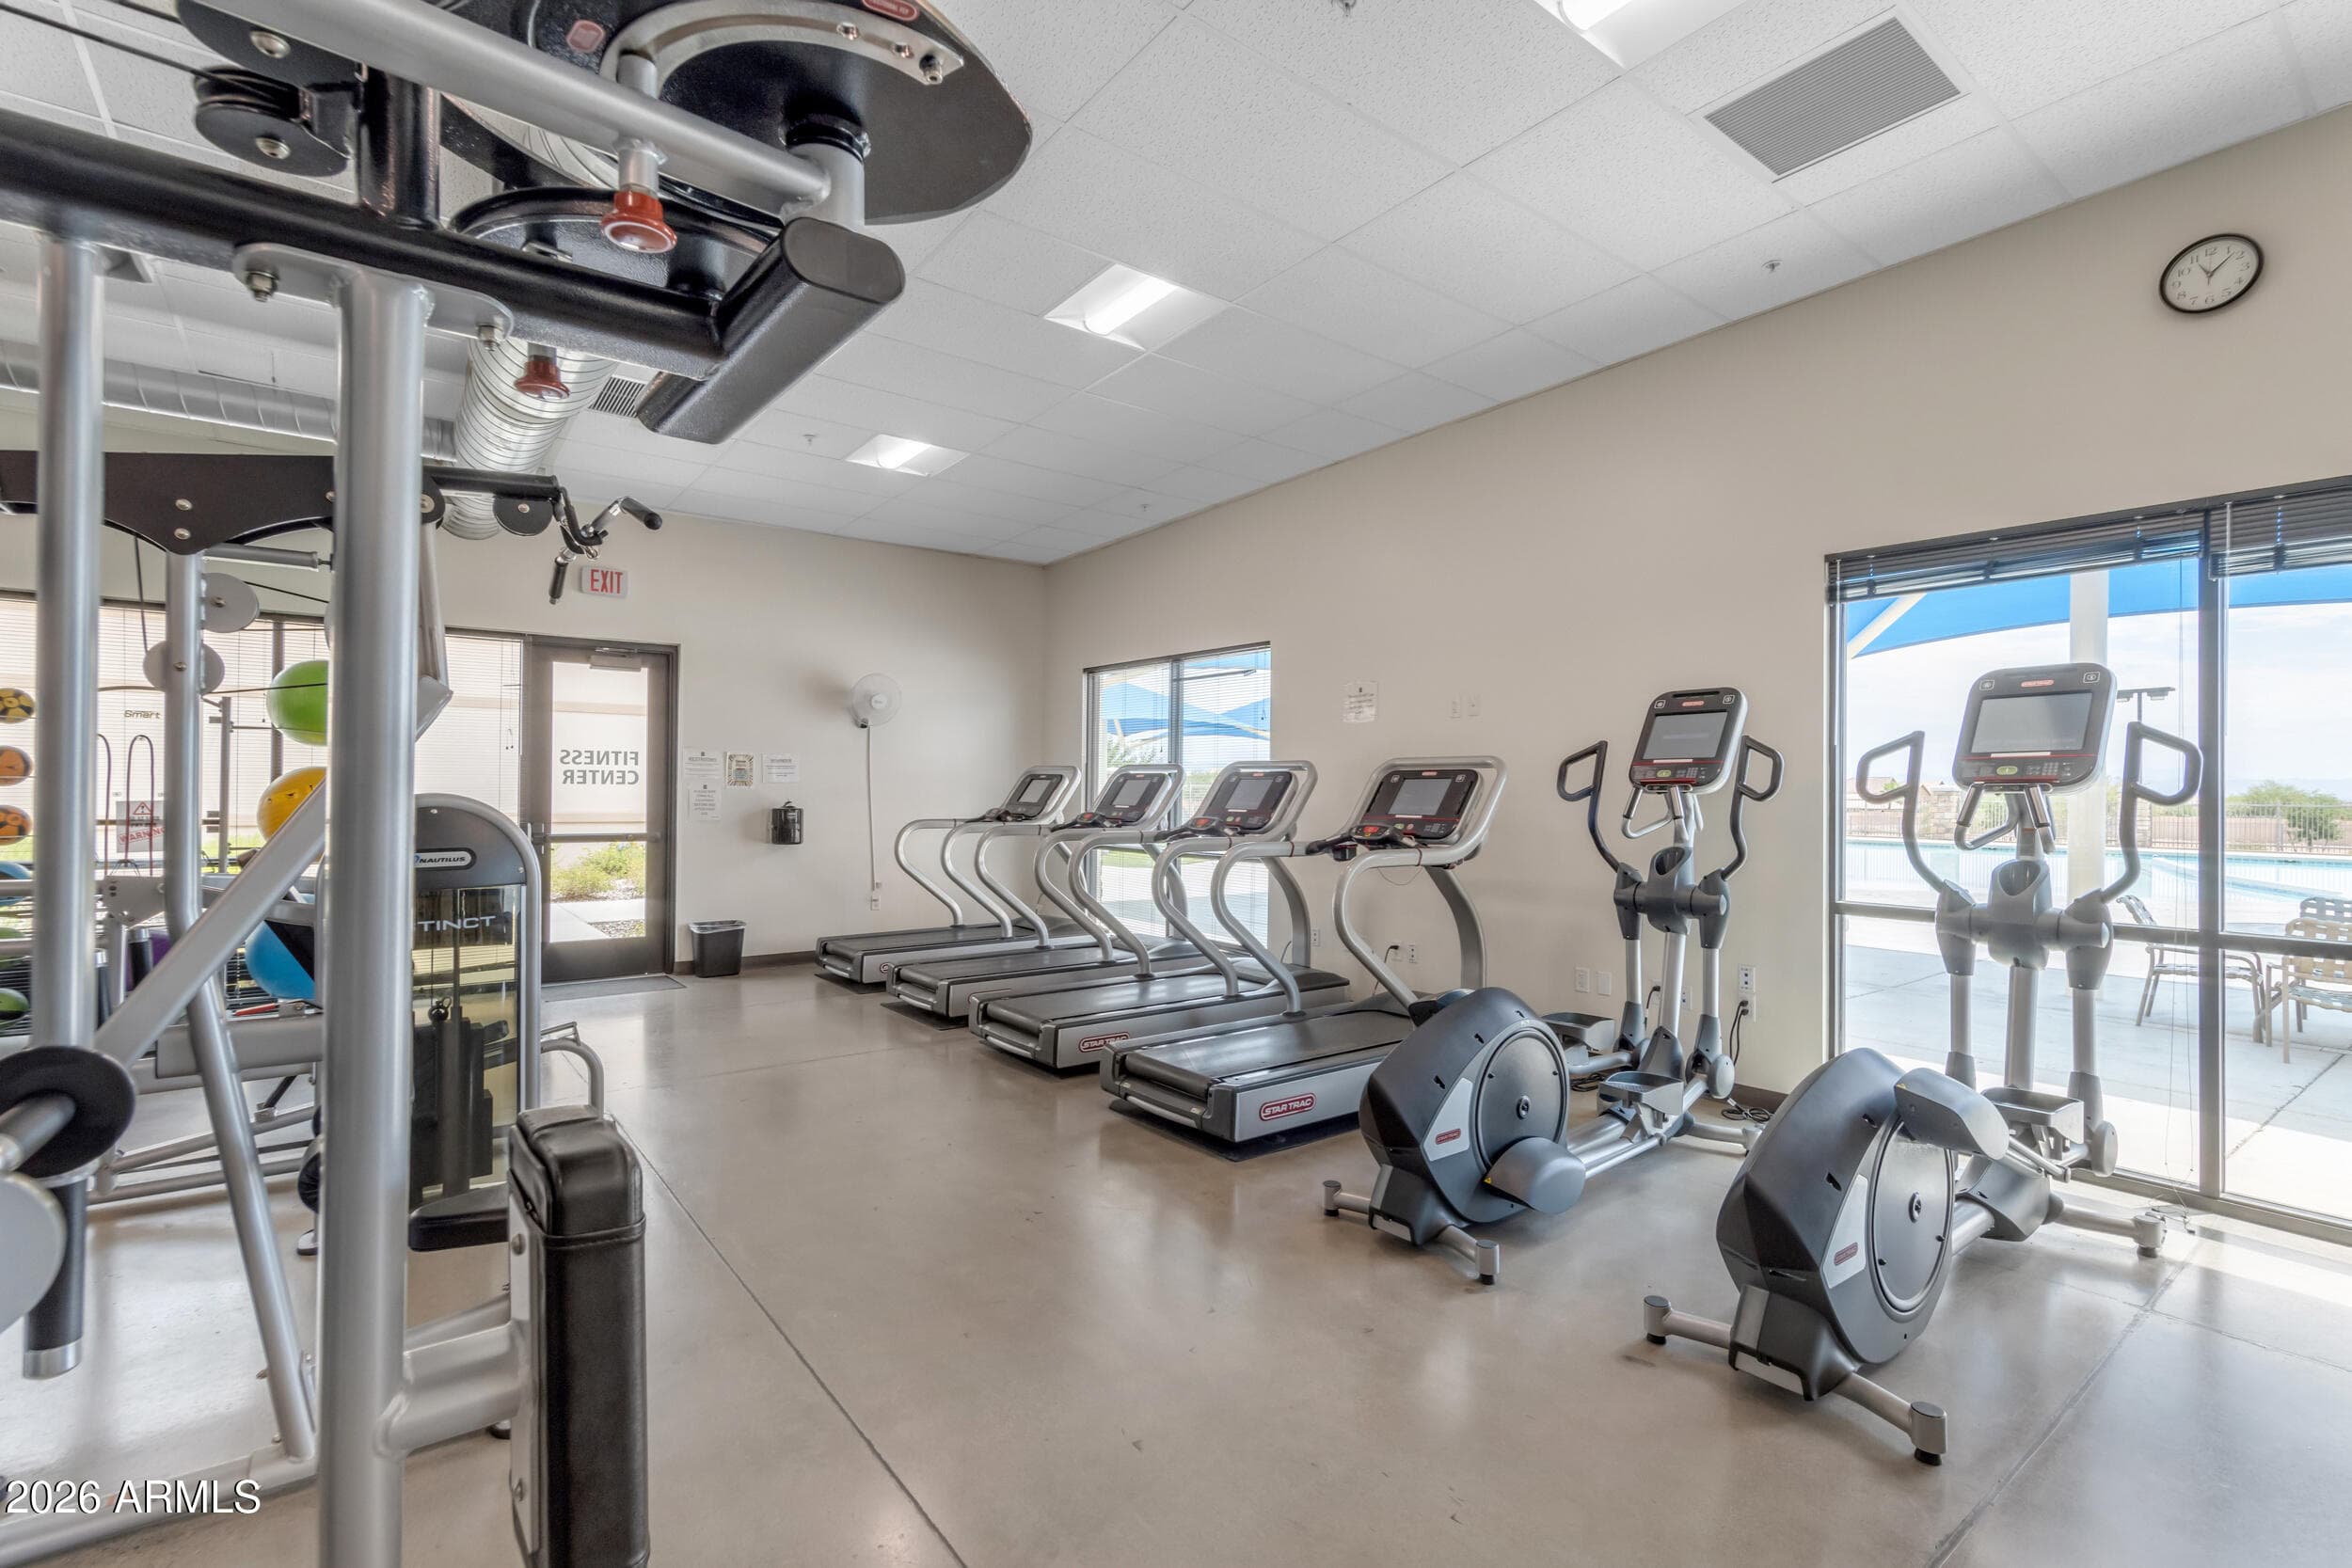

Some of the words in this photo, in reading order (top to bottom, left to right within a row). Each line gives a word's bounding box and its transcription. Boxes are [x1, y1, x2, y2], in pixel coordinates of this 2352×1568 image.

[2204, 246, 2217, 257] 12
[2190, 255, 2199, 264] 11
[2177, 267, 2191, 277] 10
[590, 568, 624, 594] EXIT
[119, 827, 166, 843] WARNN
[417, 915, 497, 932] TINCT
[1083, 1039, 1104, 1049] STAR
[1264, 1103, 1288, 1116] STAR
[1289, 1098, 1313, 1110] TRAC
